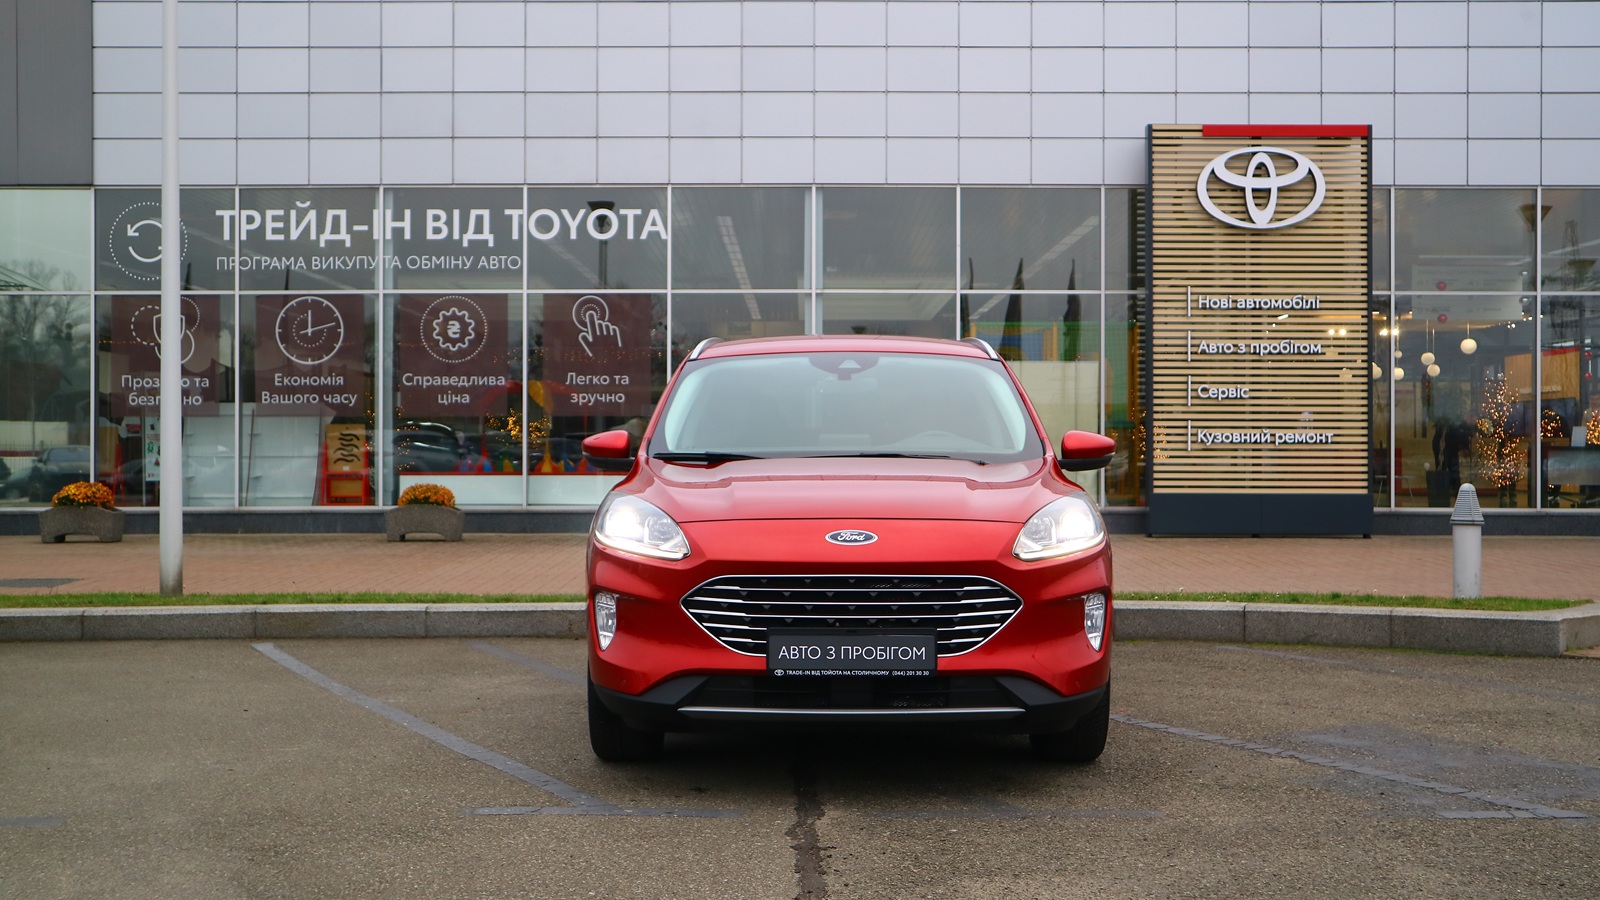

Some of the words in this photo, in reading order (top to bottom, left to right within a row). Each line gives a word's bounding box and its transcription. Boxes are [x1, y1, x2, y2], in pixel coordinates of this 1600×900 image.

[216, 201, 411, 247] ТРЕЙД-ІН
[426, 209, 494, 247] ВІД
[504, 208, 668, 241] TOYOTA
[216, 256, 306, 270] ПРОГРАМА
[312, 255, 379, 270] ВИКУПУ
[383, 255, 402, 269] ТА
[406, 255, 473, 270] ОБМІНУ
[478, 255, 521, 270] АВТО
[1198, 295, 1233, 309] Нові
[1236, 294, 1320, 310] автомобілі
[1198, 340, 1234, 354] Авто
[1237, 343, 1246, 354] з
[1250, 340, 1322, 356] пробігом
[121, 375, 190, 390] Прозо
[194, 377, 210, 388] та
[274, 373, 344, 386] Економія
[402, 373, 505, 389] Справедлива
[566, 372, 610, 386] Легко
[614, 375, 629, 386] та
[262, 391, 319, 405] Вашого
[323, 394, 357, 407] часу
[437, 391, 470, 405] ціна
[570, 392, 625, 406] зручно
[1198, 385, 1250, 401] Сервіс
[1198, 429, 1271, 446] Кузовний
[1275, 432, 1333, 446] ремонт
[837, 531, 866, 541] Ford
[778, 646, 821, 660] АВТО
[826, 646, 836, 660] З
[841, 646, 926, 660] ПРОБІГОМ
